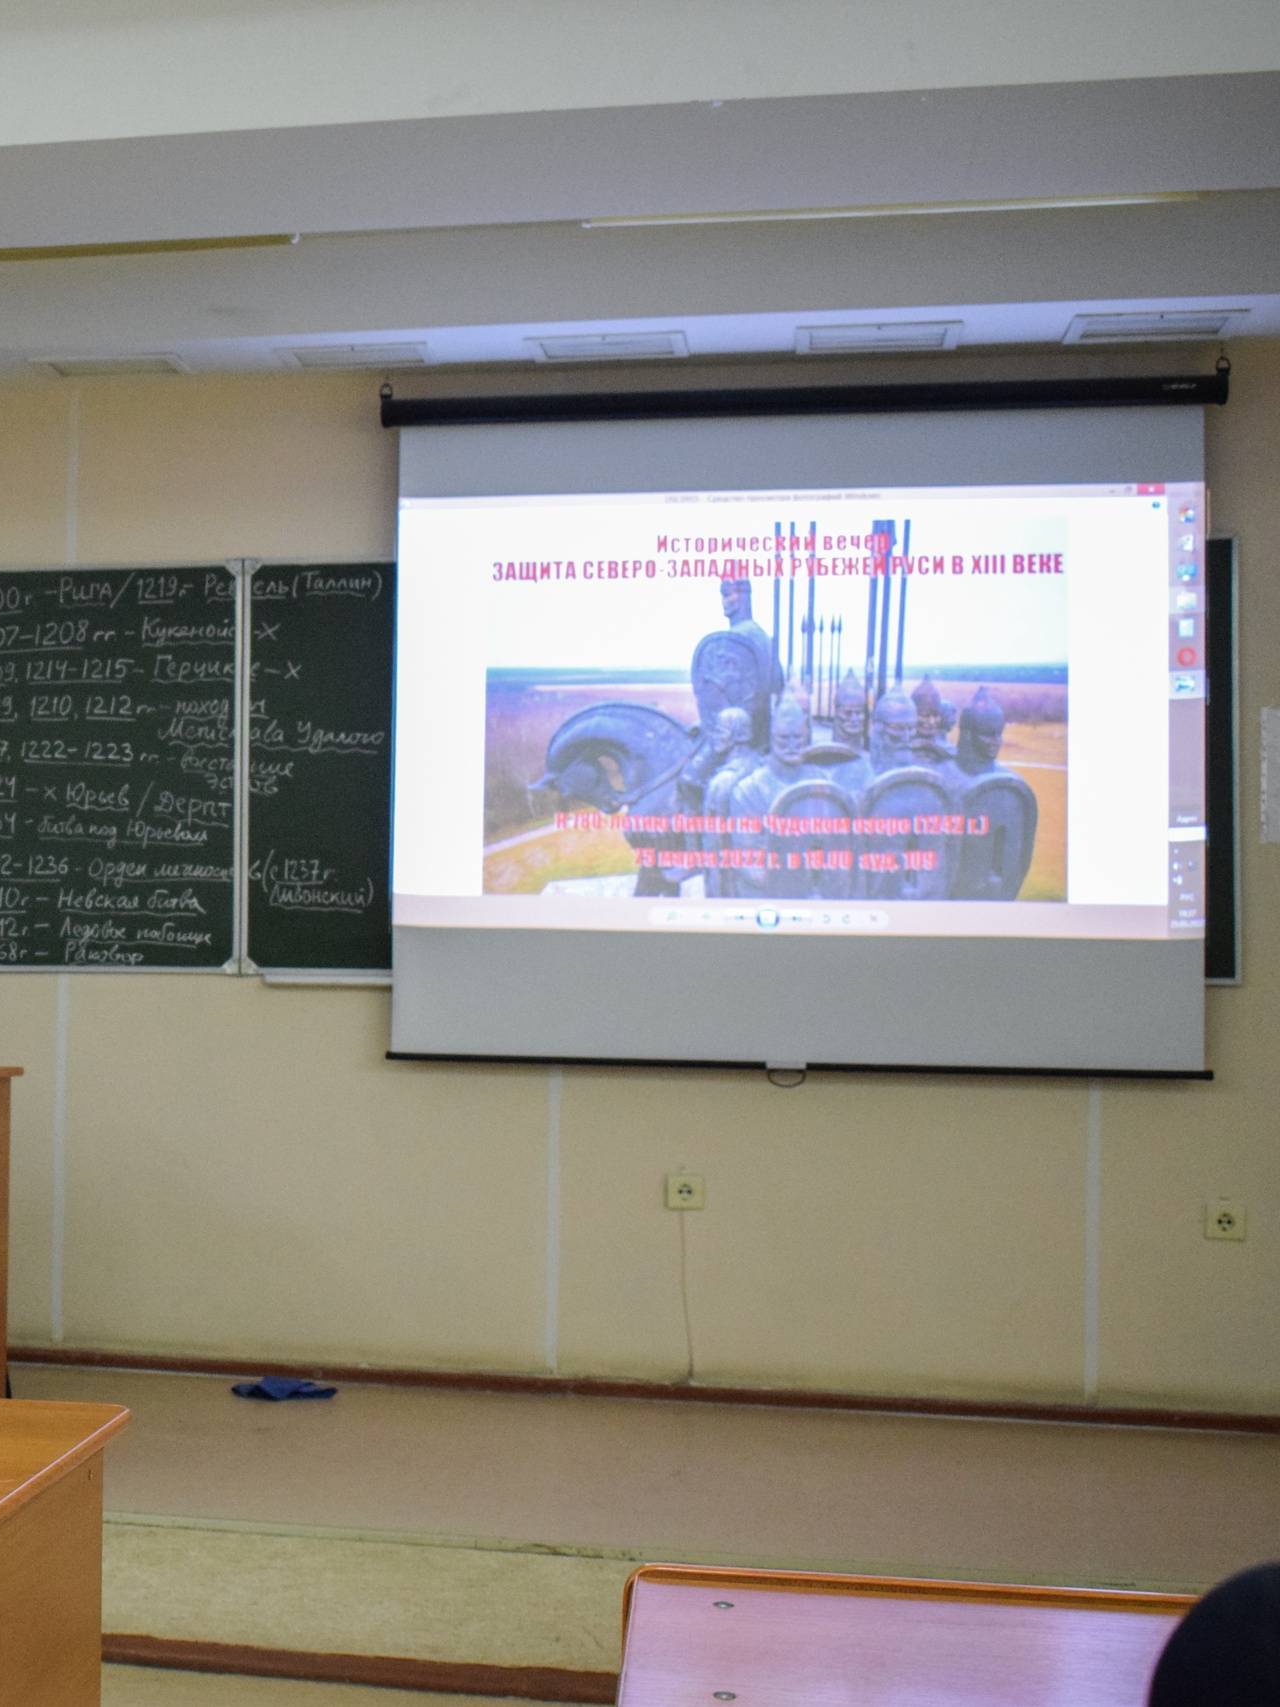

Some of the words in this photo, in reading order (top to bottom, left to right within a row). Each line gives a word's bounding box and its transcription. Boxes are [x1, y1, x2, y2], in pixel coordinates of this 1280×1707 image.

[656, 530, 816, 555] Исторический
[822, 532, 891, 555] вечер
[492, 561, 577, 583] ЗАЩИТА
[583, 556, 785, 581] СЕВЕРО-ЗАПАДНЫХ
[791, 552, 887, 577] РУБЕЖЕЙ
[891, 554, 945, 576] РУСИ
[951, 555, 965, 576] В
[1011, 553, 1064, 576] ВЕКЕ
[66, 781, 131, 811] Юрьев
[154, 790, 233, 827] Дерпт
[657, 850, 717, 871] марта
[57, 886, 140, 910] Невская
